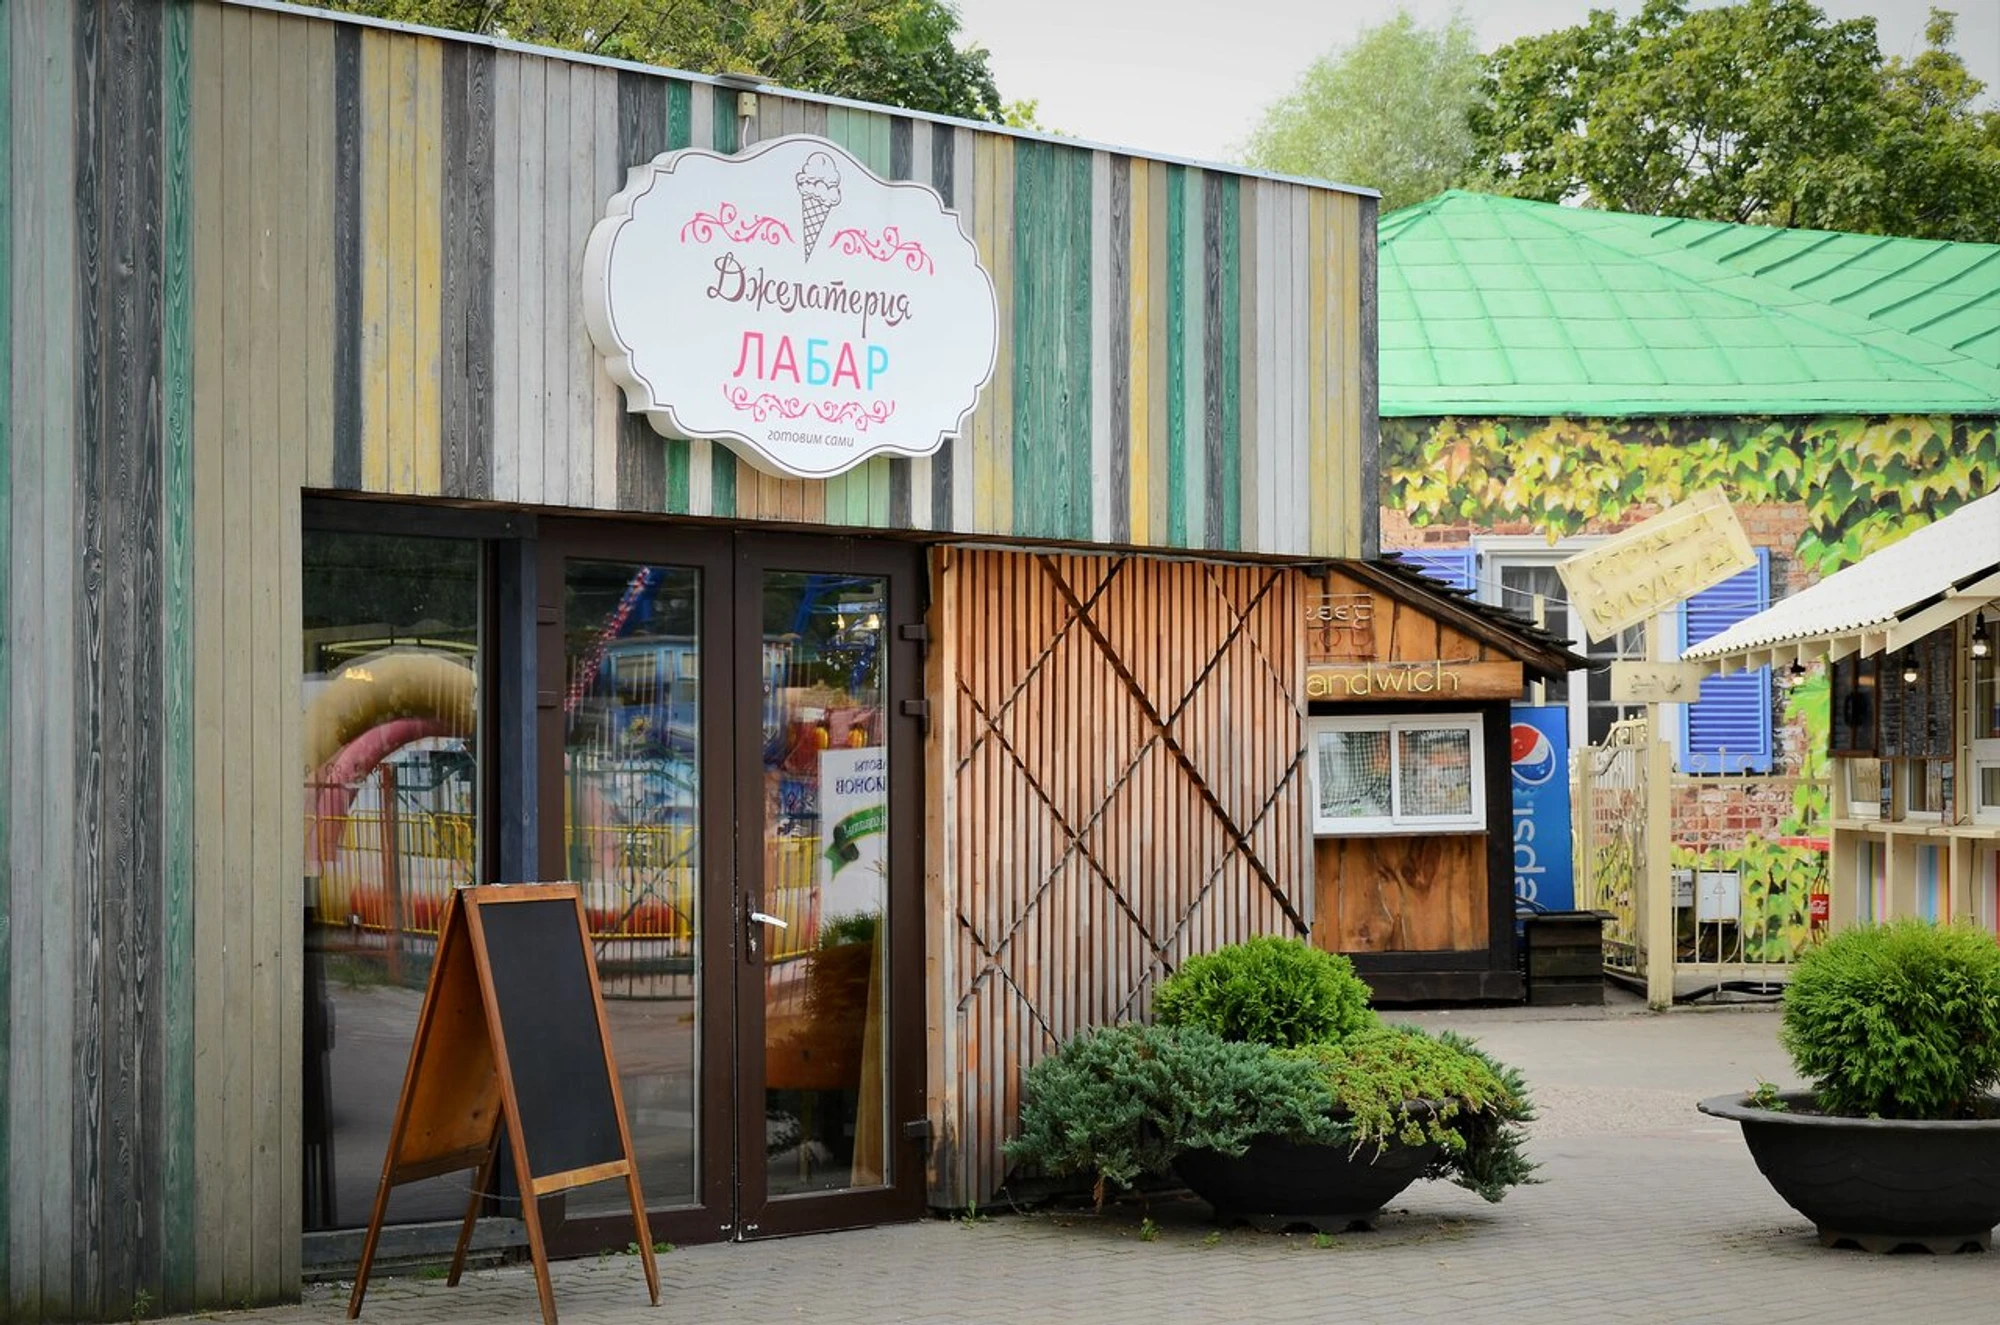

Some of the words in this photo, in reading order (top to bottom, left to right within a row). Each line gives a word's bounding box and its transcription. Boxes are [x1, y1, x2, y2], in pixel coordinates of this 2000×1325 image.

[706, 251, 913, 339] Джелатерия
[732, 331, 890, 391] ЛАБАР
[767, 429, 823, 445] готовим
[824, 434, 855, 448] сами
